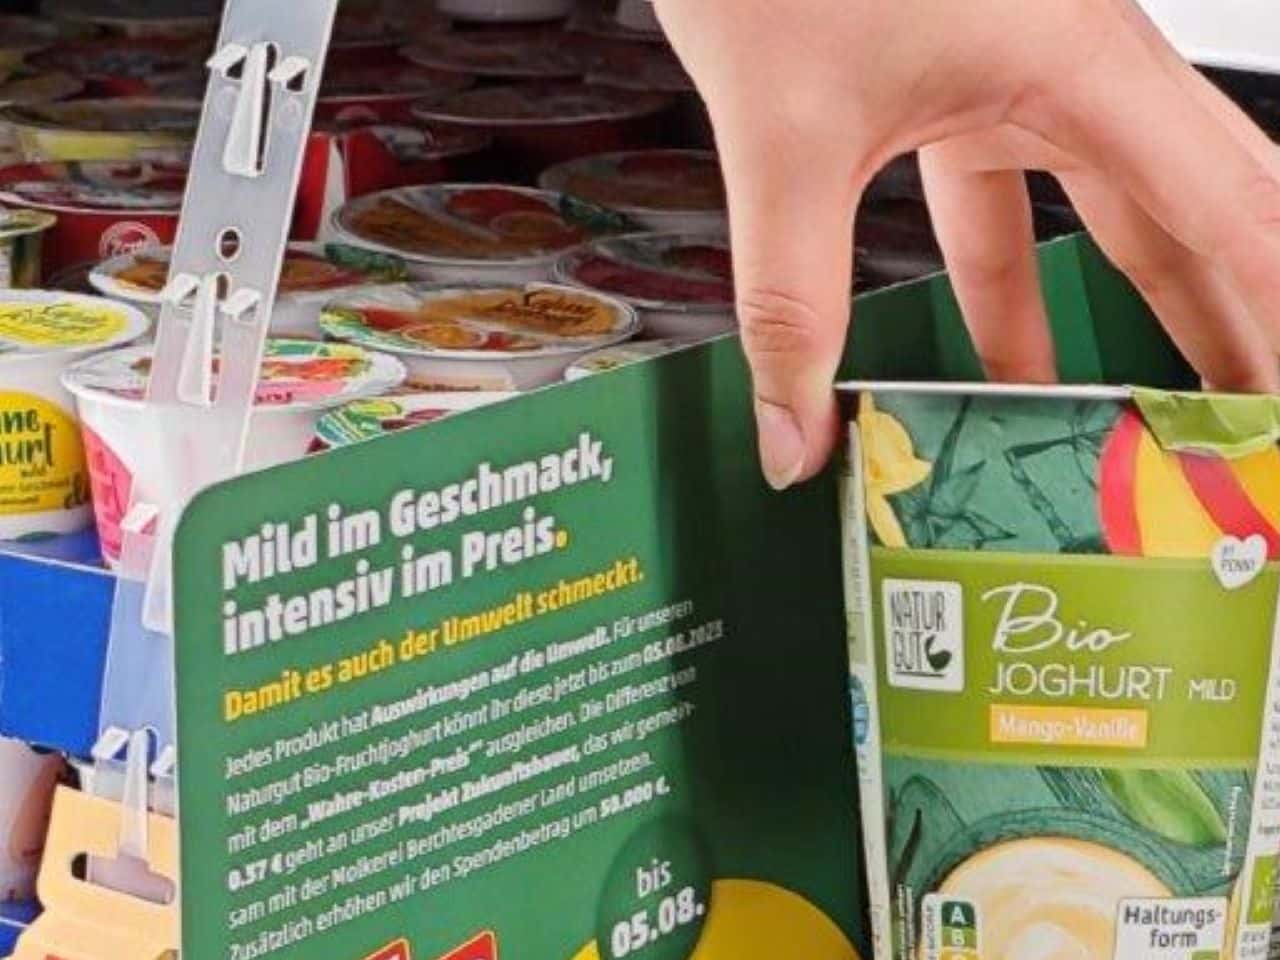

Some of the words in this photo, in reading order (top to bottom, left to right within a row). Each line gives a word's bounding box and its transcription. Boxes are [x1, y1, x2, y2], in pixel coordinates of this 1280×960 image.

[222, 514, 317, 590] Mild
[328, 503, 380, 558] im
[390, 432, 613, 537] Geschmack,
[223, 559, 393, 655] intensiv
[402, 545, 452, 597] im
[462, 506, 568, 577] Preis.
[889, 591, 946, 631] NATUR
[981, 582, 1131, 653] Bio
[225, 669, 301, 721] Damit
[305, 663, 333, 692] es
[338, 640, 394, 682] auch
[400, 628, 440, 661] der
[442, 592, 532, 646] Umwelt
[536, 556, 644, 615] schmeckt.
[893, 629, 925, 672] GUT
[988, 662, 1172, 699] JOGHURT
[1188, 680, 1236, 700] MILD
[226, 748, 272, 779] Jedes
[276, 722, 339, 760] Produkt
[342, 711, 368, 735] hat
[371, 671, 489, 725] Auswirkungen
[492, 656, 518, 684] auf
[520, 648, 545, 673] die
[998, 711, 1139, 743] Mango-Vanille
[227, 772, 301, 816] Naturgut
[228, 825, 256, 853] mit
[259, 813, 298, 842] dem
[228, 858, 267, 891] 0.37
[285, 839, 324, 874] geht
[327, 831, 348, 853] an
[351, 814, 395, 844] unser
[398, 788, 459, 826] Projekt
[316, 889, 387, 931] erhöhen
[389, 875, 417, 901] wir
[419, 863, 450, 890] den
[454, 816, 570, 878] Spendenbetrag
[574, 806, 598, 829] um
[637, 858, 672, 898] bis
[229, 898, 265, 928] sam
[269, 885, 297, 911] mit
[301, 874, 330, 900] der
[611, 887, 704, 958] 05.08.
[952, 908, 966, 925] A
[1124, 905, 1222, 926] Haltungs-
[952, 930, 965, 946] B
[1151, 928, 1198, 948] form
